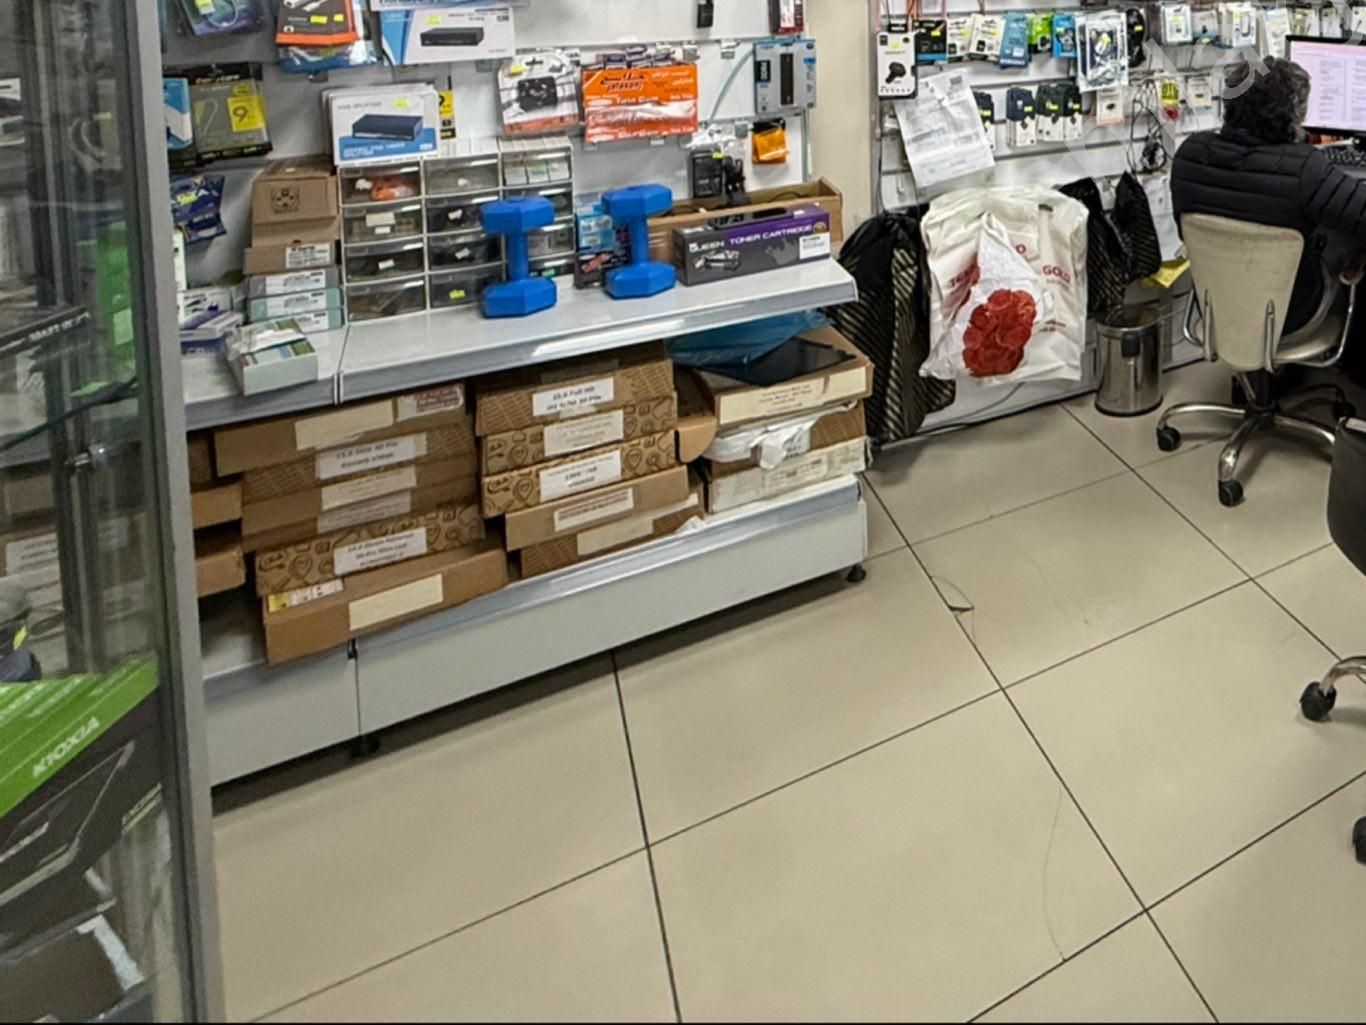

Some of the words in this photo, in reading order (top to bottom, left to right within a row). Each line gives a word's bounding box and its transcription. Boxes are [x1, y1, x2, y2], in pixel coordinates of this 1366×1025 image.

[729, 233, 762, 245] TONER
[762, 224, 813, 240] CARTRIDGE
[32, 715, 100, 778] KIOXIA
